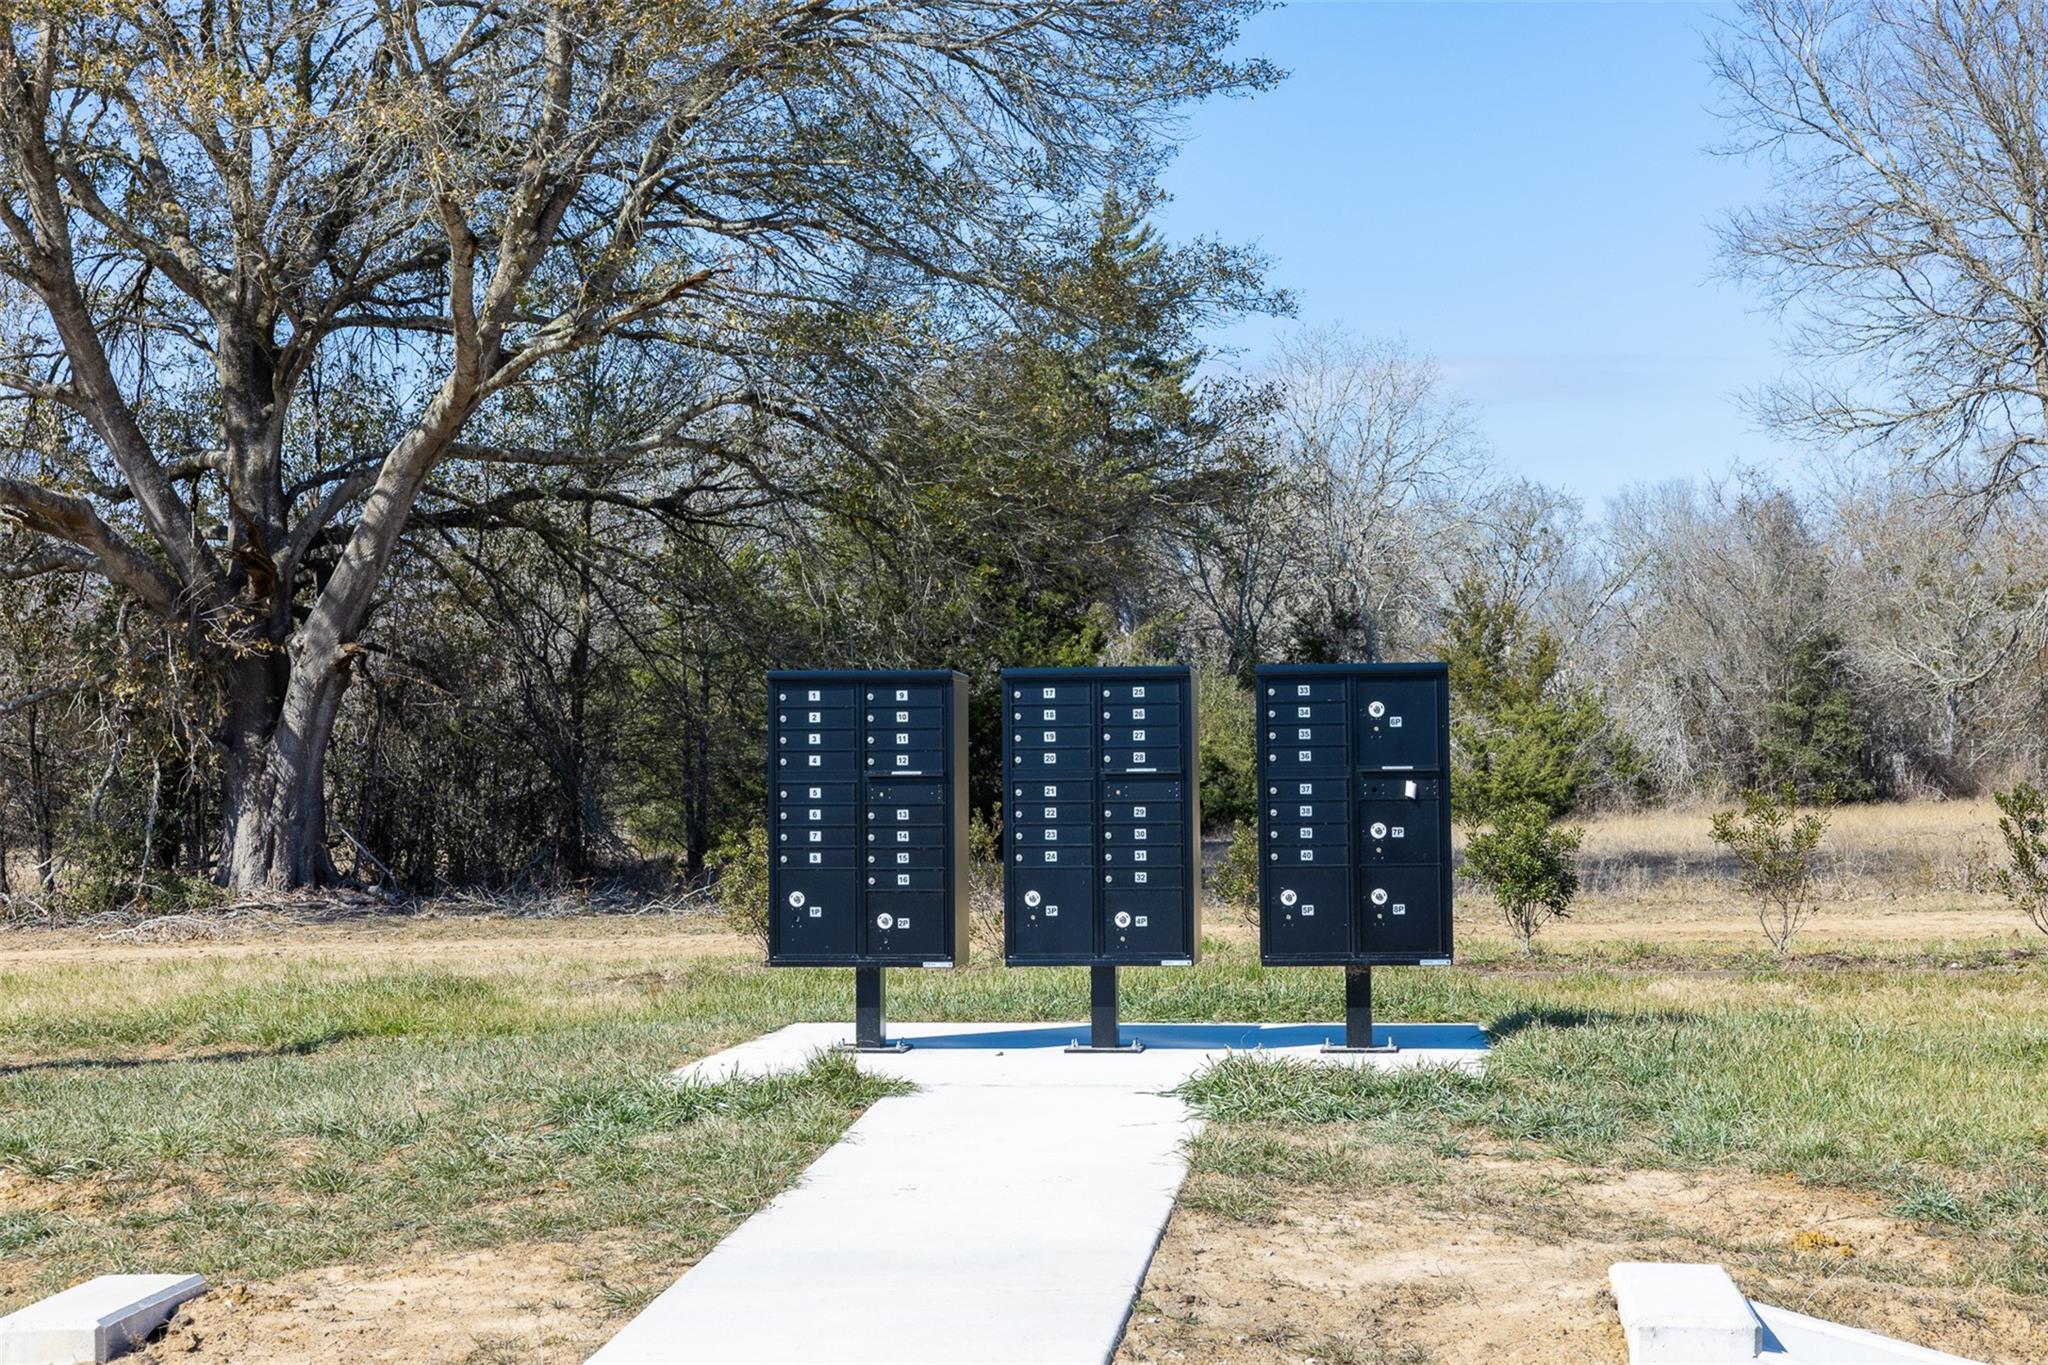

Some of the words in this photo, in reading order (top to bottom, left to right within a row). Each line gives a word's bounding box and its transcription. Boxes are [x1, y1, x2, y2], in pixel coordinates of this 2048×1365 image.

[1044, 689, 1054, 697] 17
[1133, 688, 1144, 696] 25
[1299, 686, 1309, 695] 33
[1045, 711, 1055, 719] 18
[1134, 710, 1144, 718] 26
[1299, 708, 1310, 717] 34
[898, 713, 908, 721] 10
[1390, 718, 1402, 726] 6P
[1045, 732, 1055, 741] 19
[1134, 731, 1144, 740] 27
[1299, 730, 1310, 738] 35
[897, 735, 907, 743] 11
[898, 756, 908, 764] 12
[1045, 754, 1056, 762] 20
[1134, 753, 1144, 762] 28
[1300, 752, 1310, 761] 36
[1045, 787, 1055, 795] 21
[1300, 785, 1311, 794] 37
[898, 810, 908, 819] 13
[1046, 809, 1056, 817] 22
[1135, 808, 1145, 816] 29
[1300, 807, 1312, 816] 38
[1046, 830, 1056, 839] 23
[1135, 830, 1146, 838] 30
[1301, 829, 1312, 837] 39
[1392, 828, 1404, 836] 7P
[898, 854, 908, 862] 15
[1046, 852, 1056, 861] 24
[1135, 852, 1145, 860] 31
[1301, 851, 1312, 860] 40
[898, 876, 908, 884] 16
[1136, 873, 1146, 882] 32
[810, 908, 821, 916] 1P
[1046, 906, 1058, 915] 3P
[1302, 906, 1314, 915] 5P
[1393, 905, 1405, 914] 8P
[898, 919, 909, 928] 2P
[1136, 917, 1147, 925] 4P
